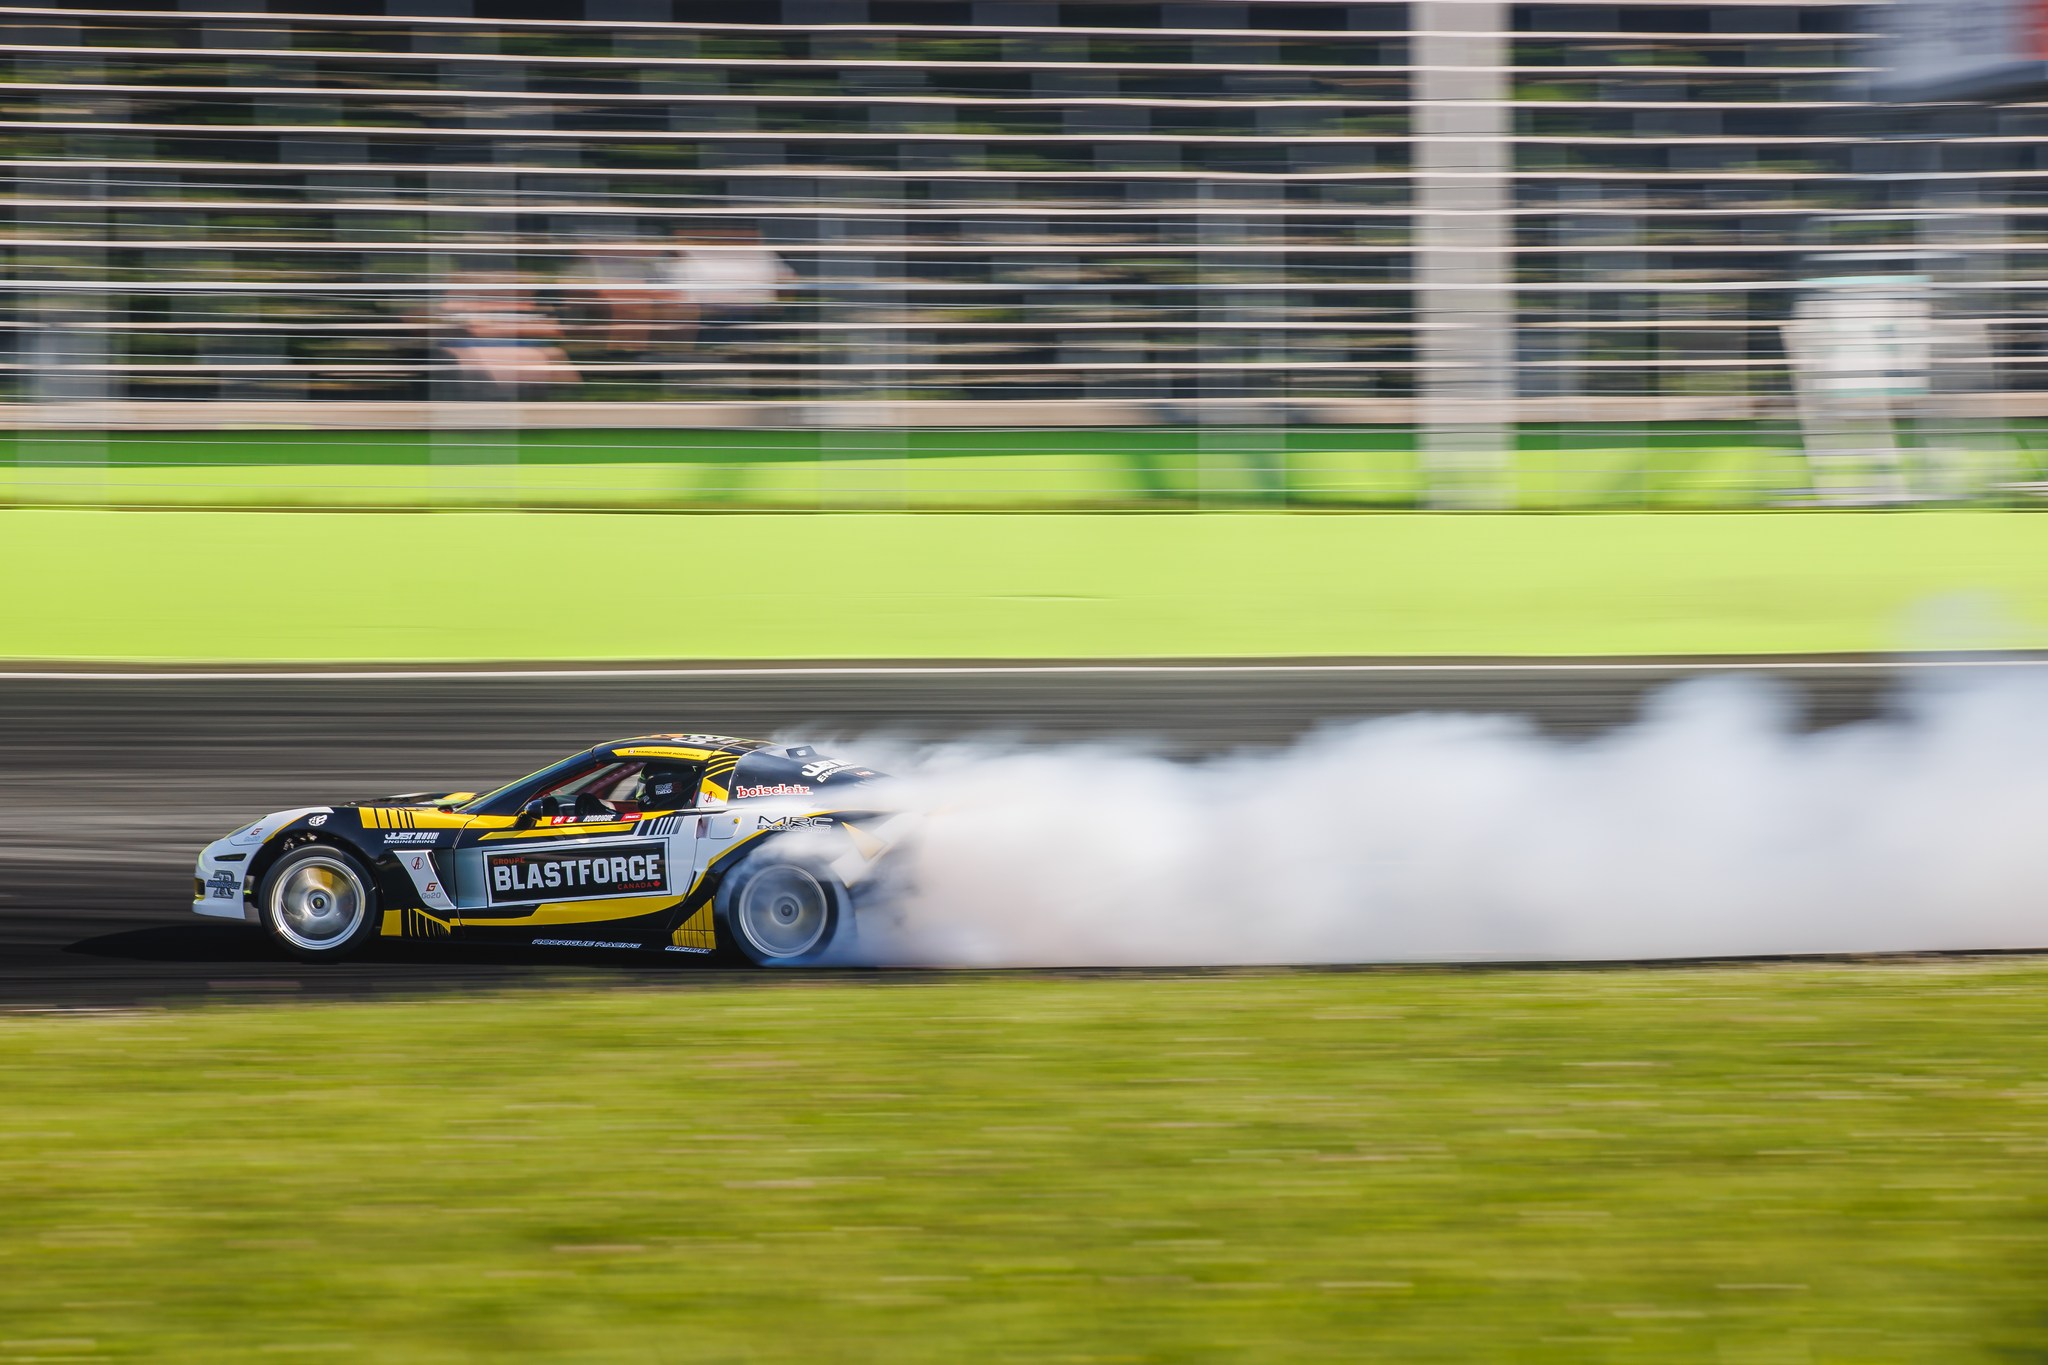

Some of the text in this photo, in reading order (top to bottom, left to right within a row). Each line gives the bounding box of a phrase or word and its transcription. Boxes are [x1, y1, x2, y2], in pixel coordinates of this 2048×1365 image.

[737, 784, 811, 799] boisclair
[758, 815, 833, 828] MRC
[384, 832, 417, 840] JUST
[492, 856, 526, 866] GROUPE
[494, 853, 662, 892] BLASTFORCE
[617, 879, 653, 891] CANADA
[421, 892, 442, 900] Go20
[532, 939, 642, 949] RODRIGUE RACING
